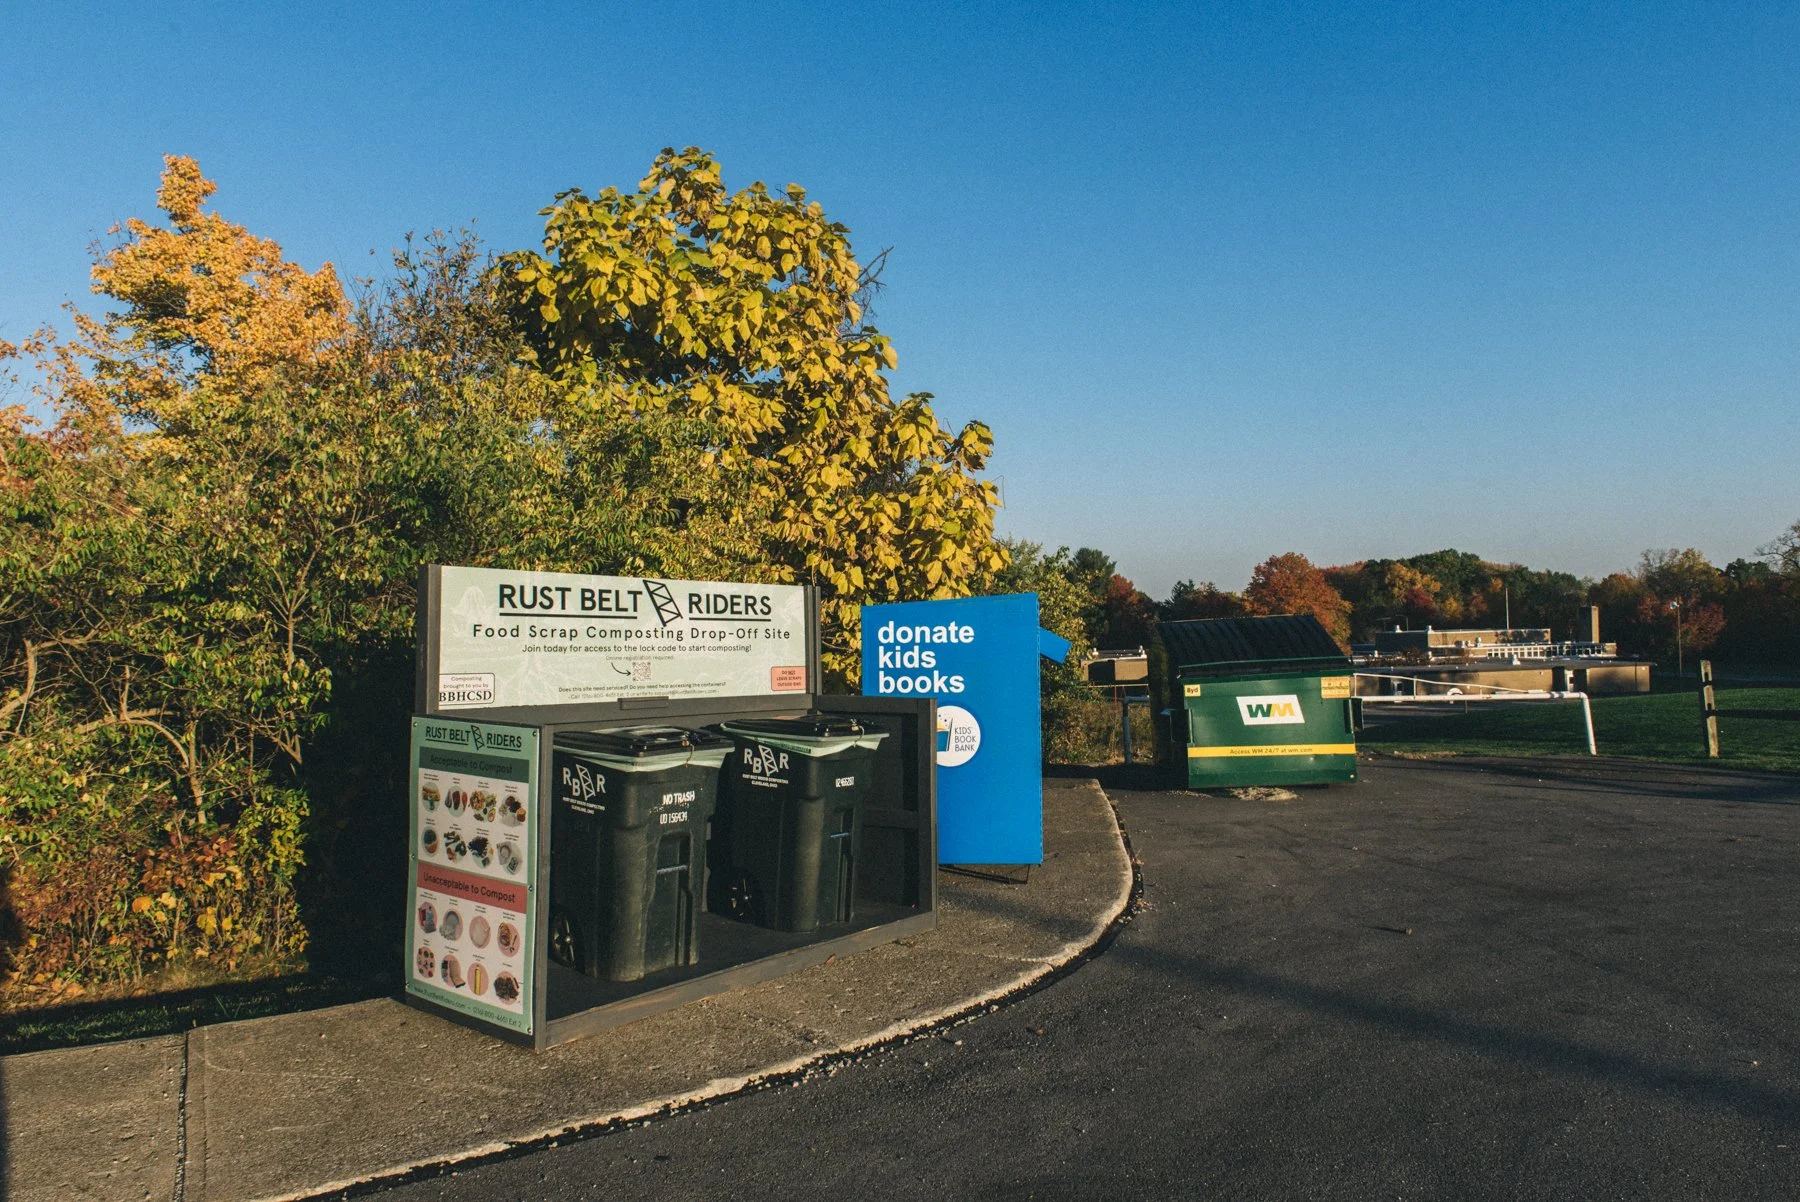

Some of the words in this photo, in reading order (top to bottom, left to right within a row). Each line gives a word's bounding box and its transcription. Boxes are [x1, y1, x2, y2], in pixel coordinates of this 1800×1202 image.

[499, 584, 572, 610] RUST
[580, 588, 643, 612] BELT
[688, 593, 772, 616] RIDERS
[473, 624, 520, 638] Food
[529, 625, 578, 641] Scrap
[586, 626, 684, 642] Composting
[691, 627, 758, 641] Drop-Off
[764, 628, 790, 639] Site
[877, 620, 975, 644] donate
[522, 644, 541, 653] Join
[543, 644, 567, 654] today
[569, 644, 582, 652] for
[624, 644, 638, 652] the
[639, 644, 655, 652] lock
[657, 644, 677, 652] code
[707, 645, 752, 653] composting!
[878, 645, 937, 669] kids
[878, 670, 966, 694] books
[439, 690, 492, 702] BBHCSD
[1246, 703, 1296, 718] WM
[425, 726, 448, 739] RUST
[449, 729, 471, 742] BELT
[486, 732, 522, 748] RIDERS
[954, 735, 977, 744] BOOK
[954, 744, 975, 752] BANK
[430, 754, 469, 768] Acceptable
[469, 761, 478, 770] to
[479, 760, 513, 775] Compost
[662, 793, 673, 805] NO
[673, 790, 696, 805] TRASH
[423, 871, 470, 892] Unacceptable
[471, 884, 480, 895] to
[480, 886, 516, 903] Compost
